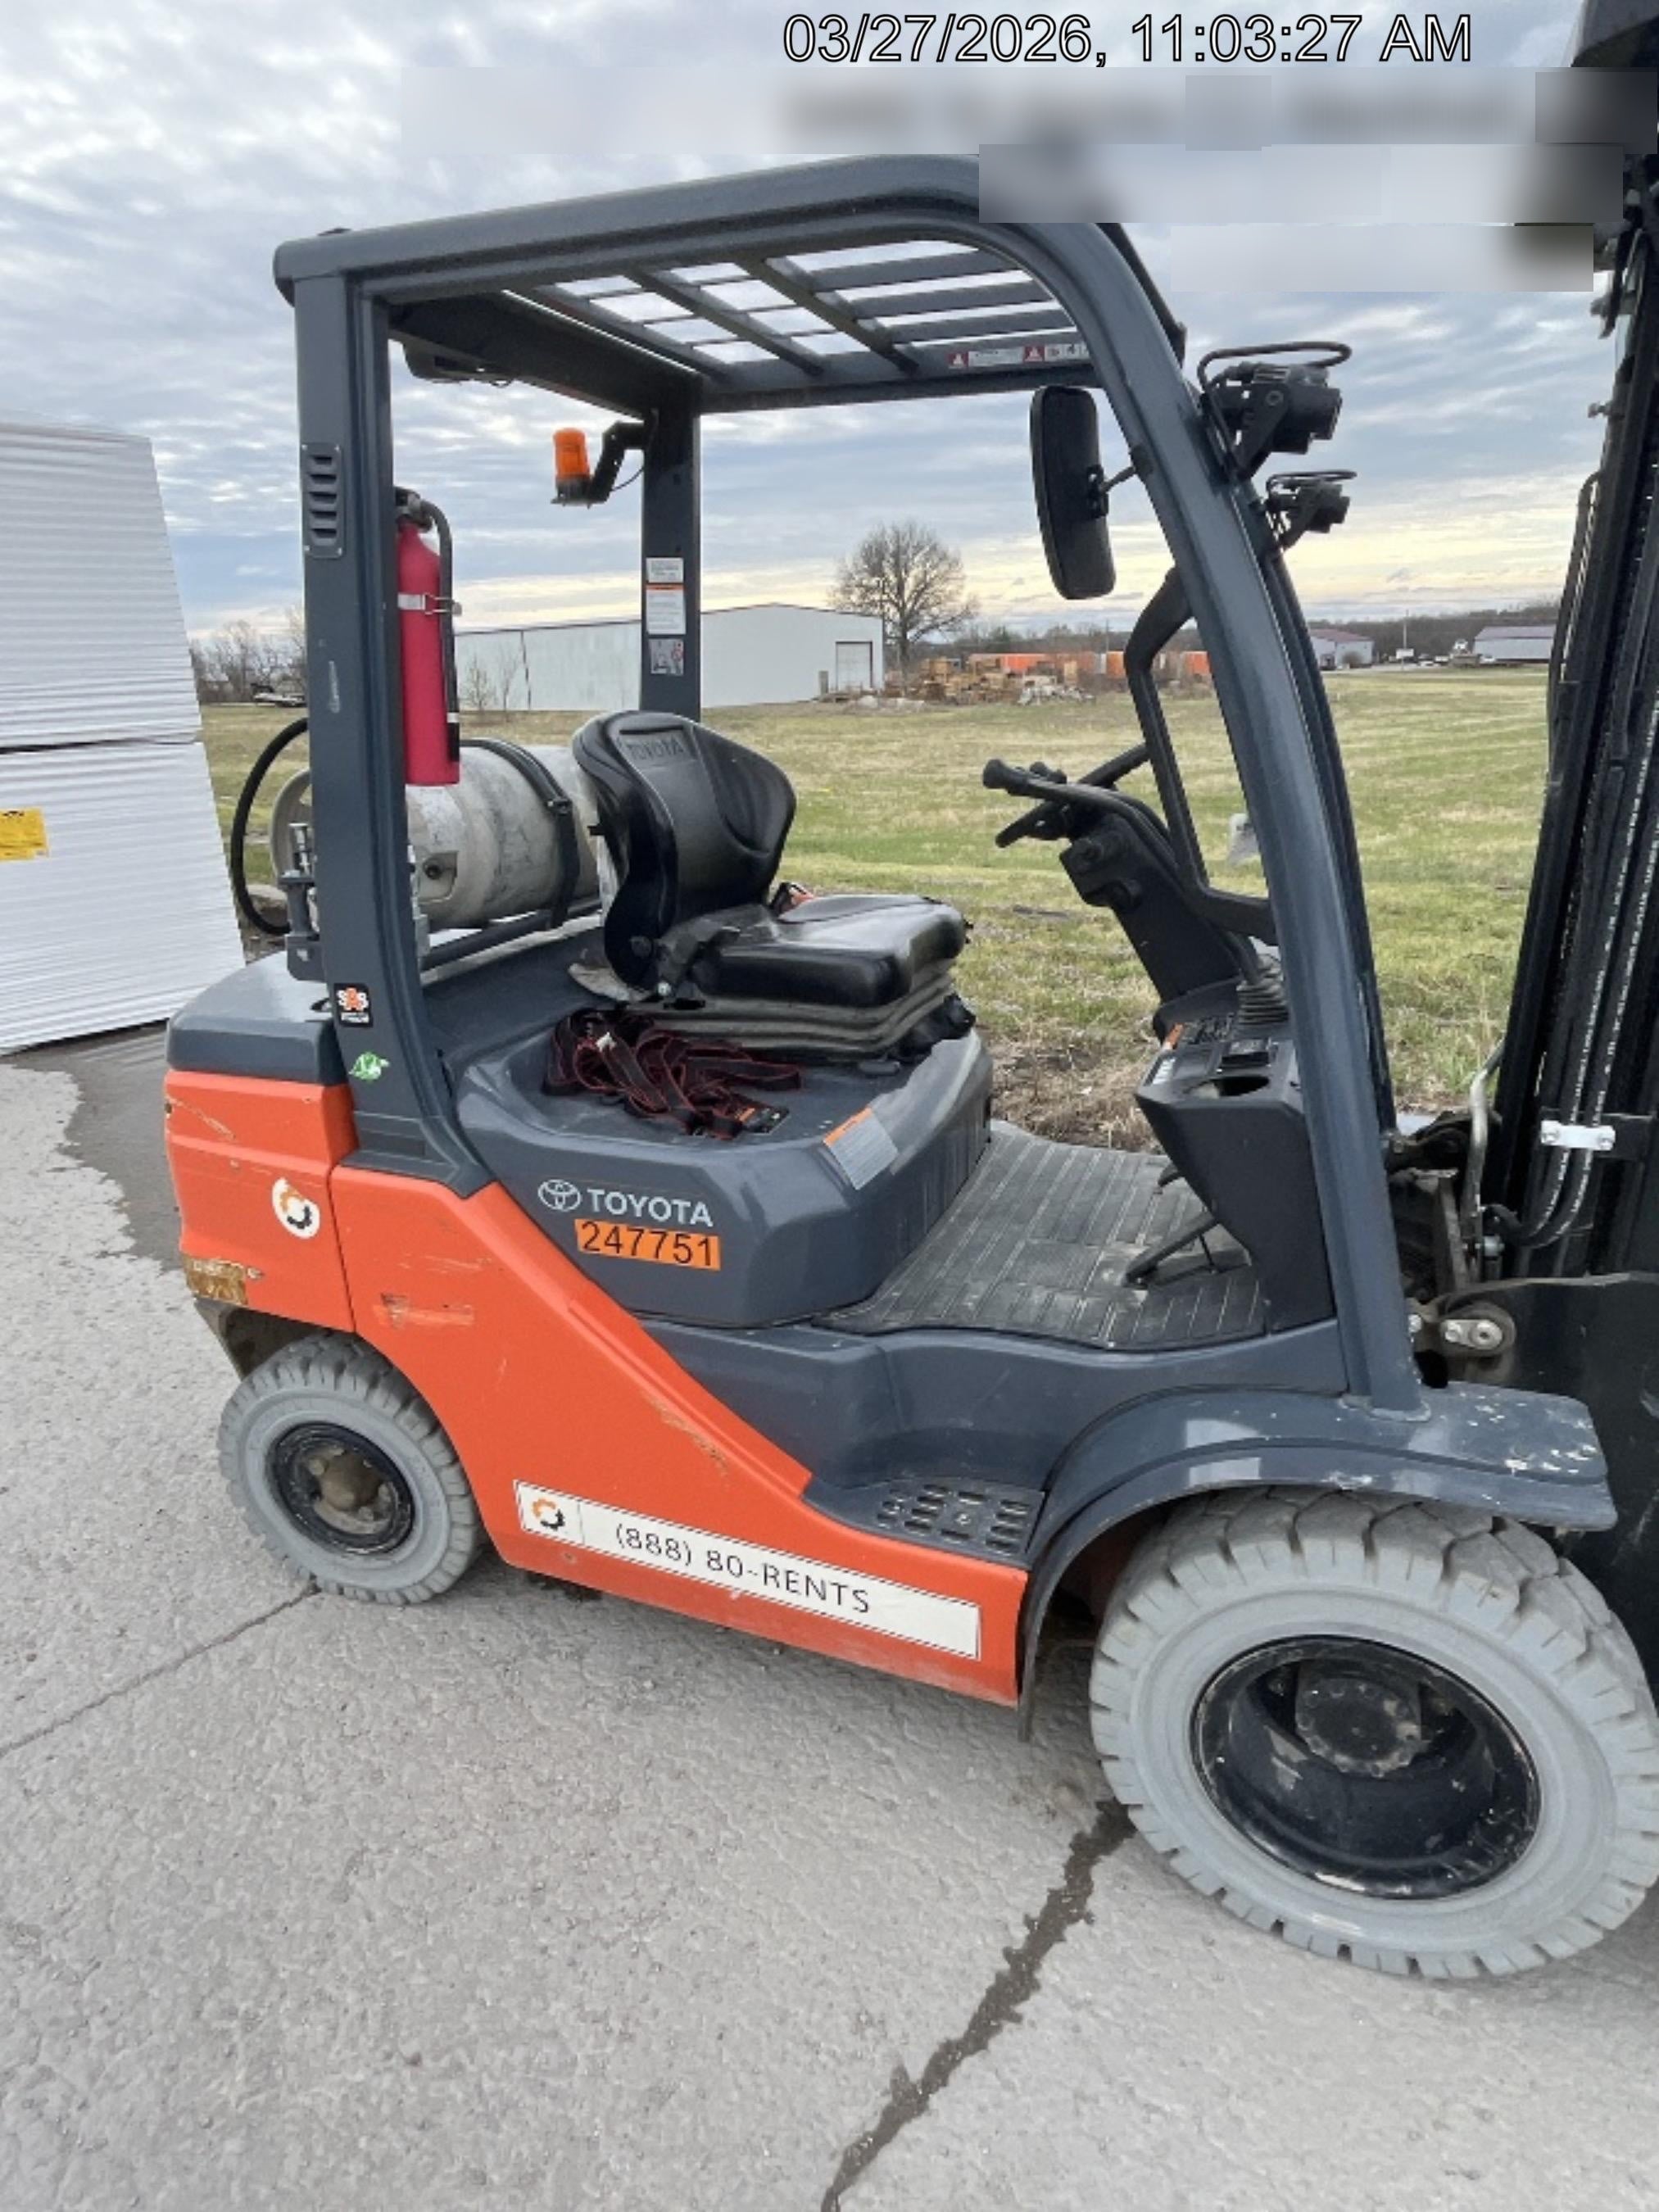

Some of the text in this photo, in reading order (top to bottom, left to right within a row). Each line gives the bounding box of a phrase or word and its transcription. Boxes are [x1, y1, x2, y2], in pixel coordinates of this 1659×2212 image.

[587, 1189, 714, 1226] TOYOTA
[581, 1221, 712, 1267] 247751
[615, 1522, 870, 1614] (888) 80-RENTS
